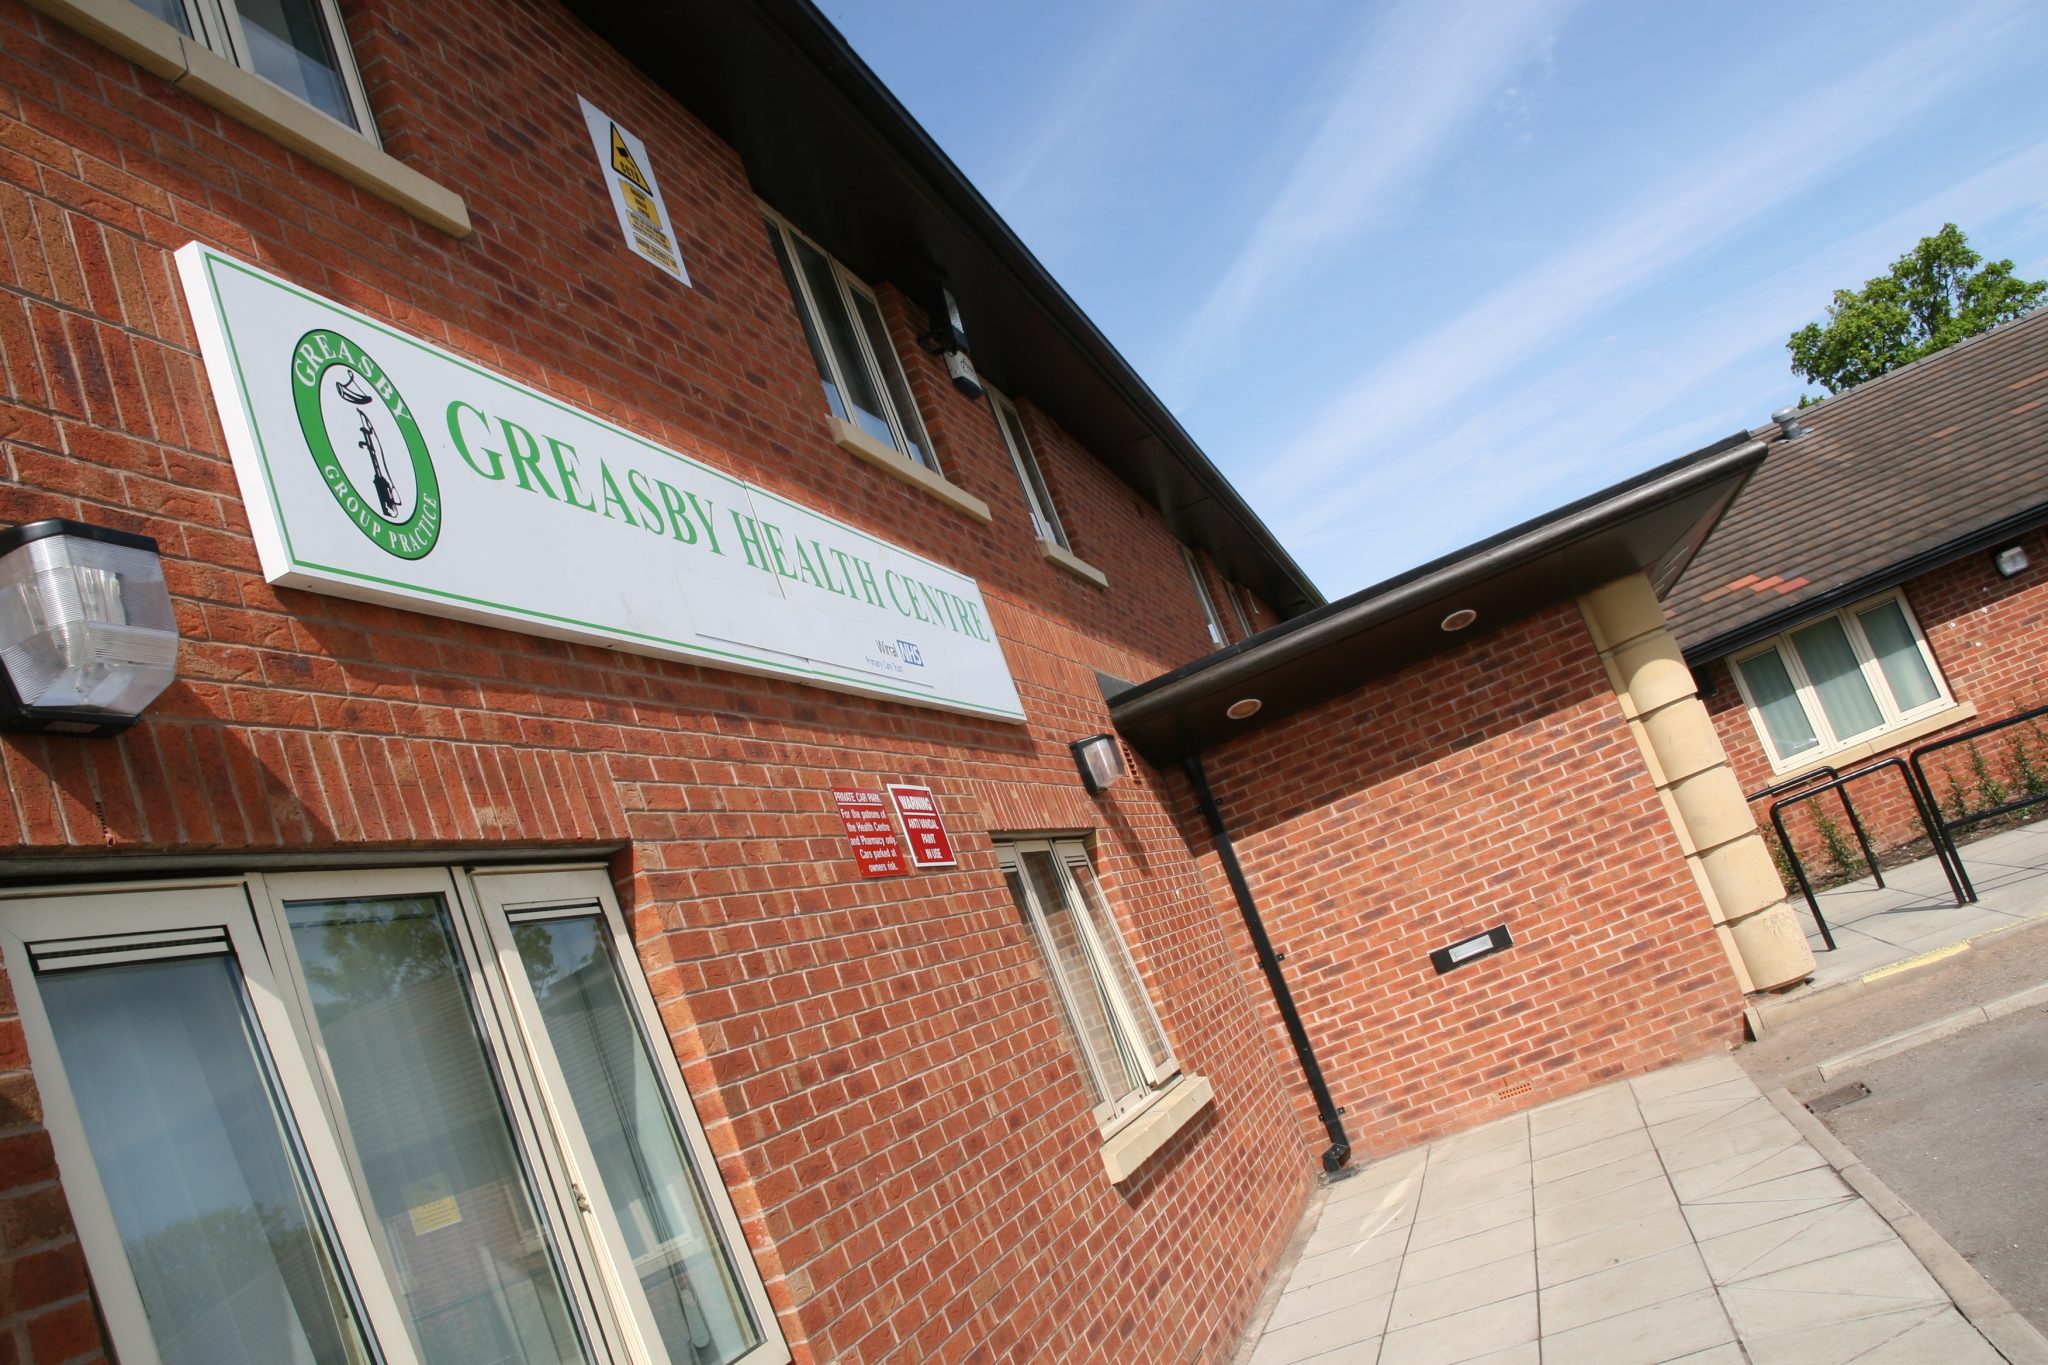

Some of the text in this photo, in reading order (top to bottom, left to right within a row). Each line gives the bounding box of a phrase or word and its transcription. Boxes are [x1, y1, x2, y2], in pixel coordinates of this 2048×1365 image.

[295, 334, 411, 420] GREASBY
[325, 465, 438, 554] GROUP PRACTICE
[446, 400, 992, 643] GREASBY HEALTH CENTRE
[874, 639, 923, 666] Wirral NHS
[865, 656, 883, 671] Primary
[833, 791, 882, 803] PRIVATE CAR PARK
[898, 796, 933, 810] WARNING
[840, 809, 887, 820] For the patrons of
[847, 822, 890, 832] the Health Centre
[907, 818, 939, 830] ANTI VANDAL
[850, 836, 860, 846] and
[860, 835, 885, 847] Pharmacy
[921, 833, 936, 844] PAINT
[860, 848, 897, 860] Cars parked at
[924, 848, 943, 859] IN USE
